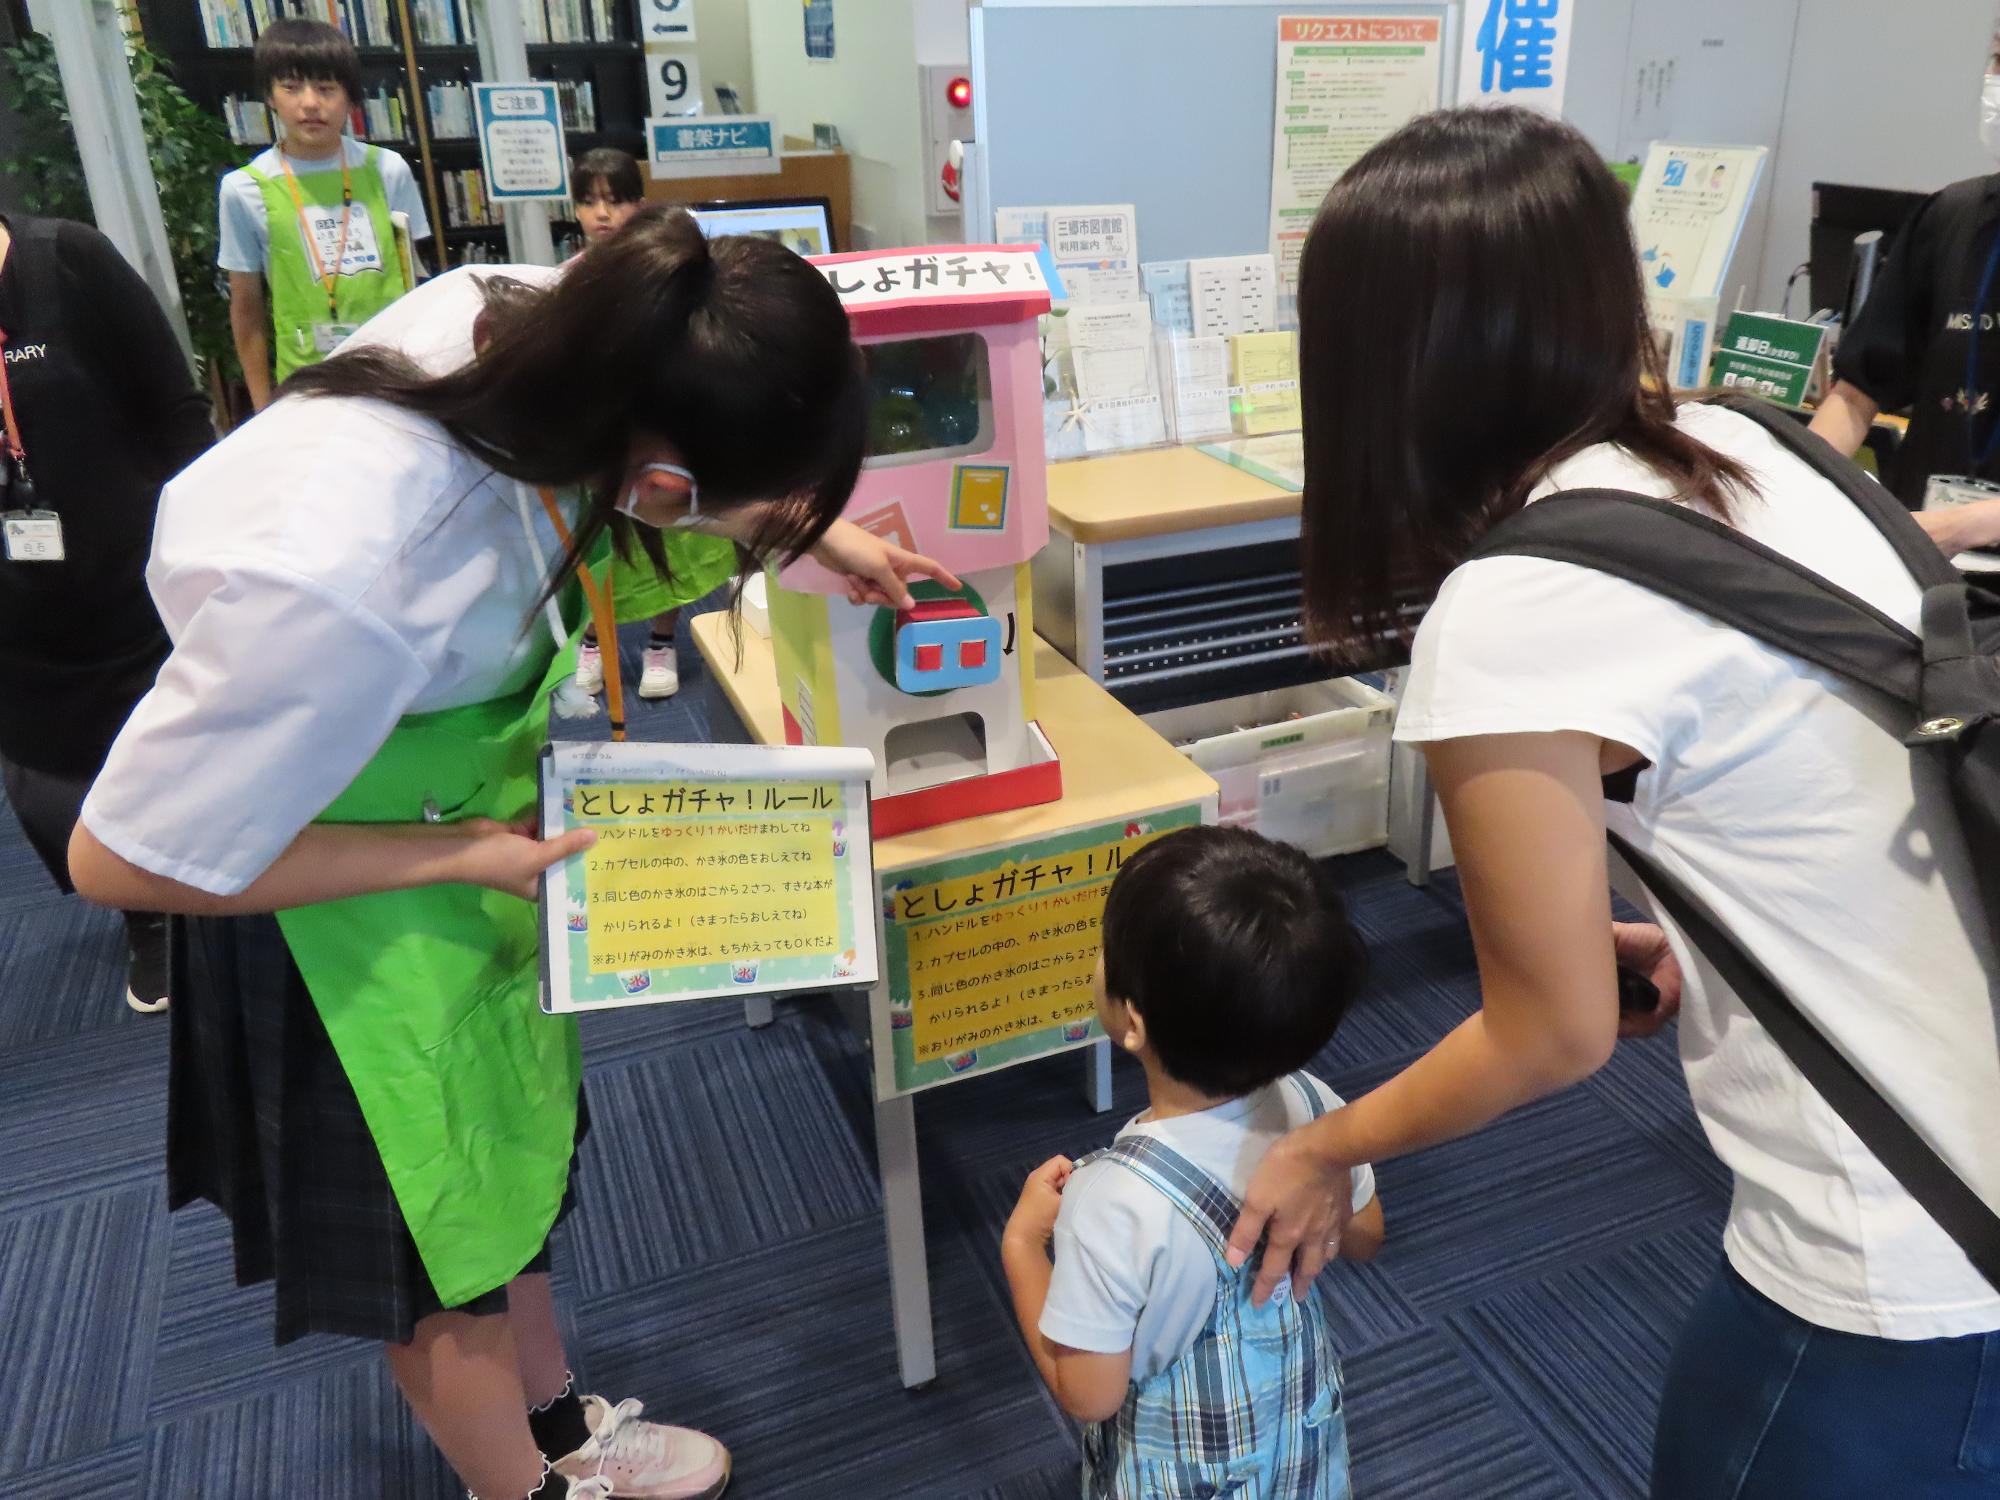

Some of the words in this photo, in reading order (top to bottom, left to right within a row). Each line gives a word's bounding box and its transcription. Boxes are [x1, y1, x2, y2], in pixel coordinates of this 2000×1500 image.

[1296, 23, 1425, 40] リクエストについて
[661, 60, 687, 101] 9
[828, 255, 1037, 294] しょガチャ！
[4, 343, 46, 364] RARY
[581, 787, 833, 816] としょガチャ！ルール
[600, 823, 811, 840] .ハンドルをゆっくり1かいだけまわしてね
[903, 846, 1126, 919] としょガチャ！ル
[913, 885, 1112, 941] 1.ハンドルをゆっくり1かいだけま
[915, 918, 1102, 971] 2.カプセルの中の、かき氷の色を
[917, 947, 1101, 1001] 3.同じ色のかき氷のはこから2さ
[929, 973, 1095, 1025] かりられるよ！（きまったらお
[918, 1000, 1096, 1055] ※おりがみのかき氷は、もちかえ
